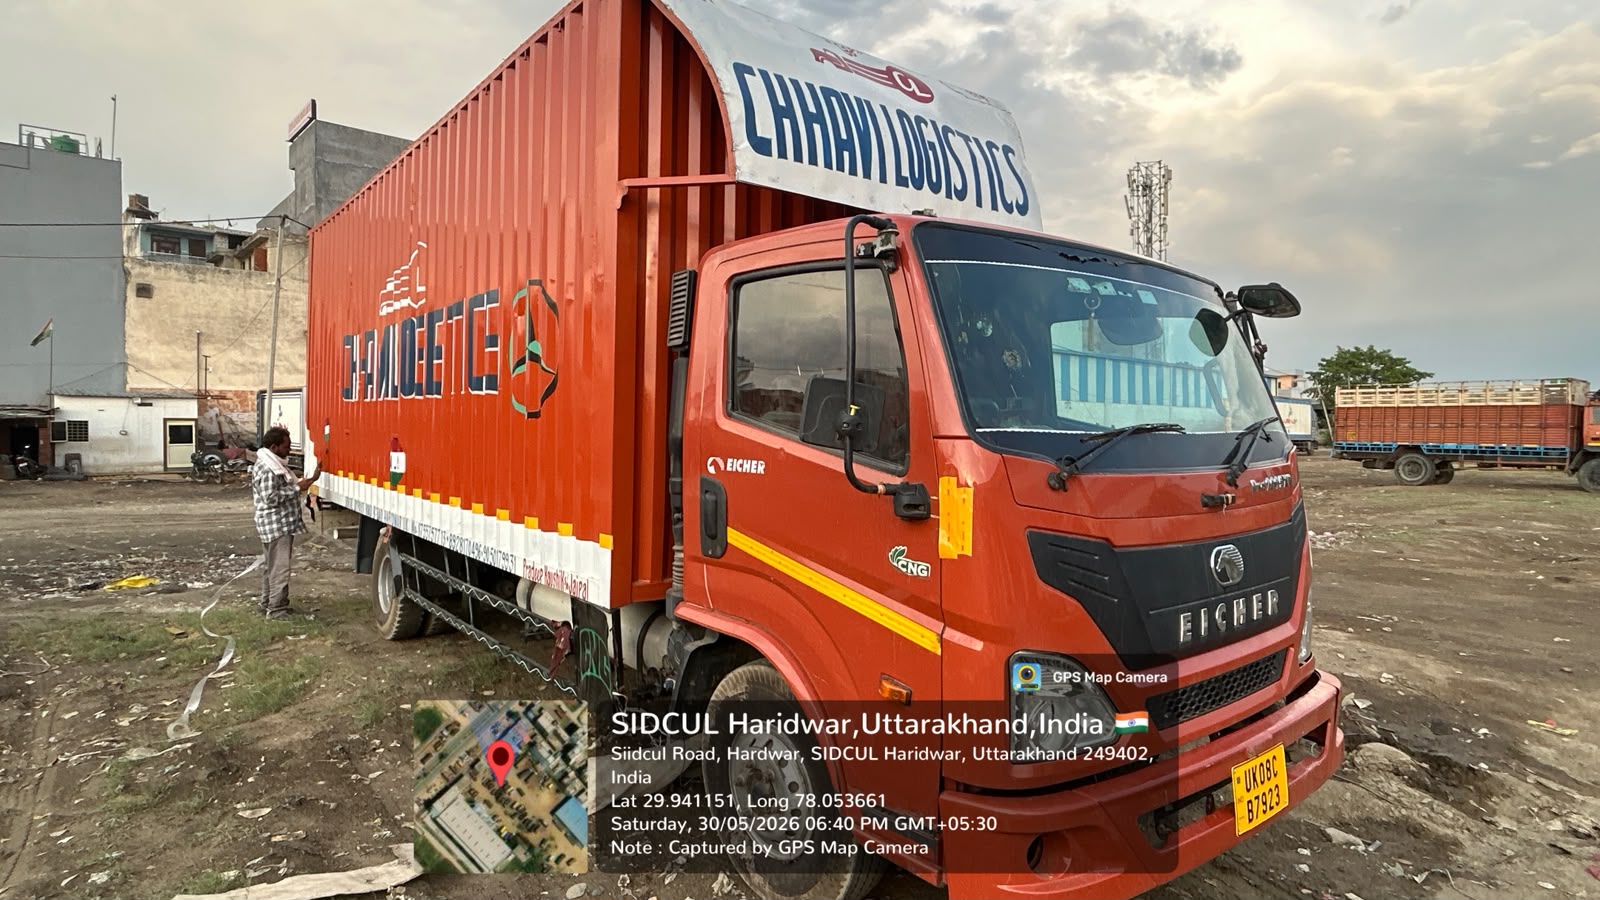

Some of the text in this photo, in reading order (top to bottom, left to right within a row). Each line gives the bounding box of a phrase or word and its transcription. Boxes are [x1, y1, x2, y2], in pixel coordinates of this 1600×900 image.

[732, 61, 1030, 217] CHHAVI LOGISTICS
[726, 458, 766, 475] EICHER
[899, 562, 930, 577] CNG
[1180, 589, 1279, 643] EICHER
[1244, 755, 1278, 793] UK08C
[1247, 784, 1280, 824] B7923
